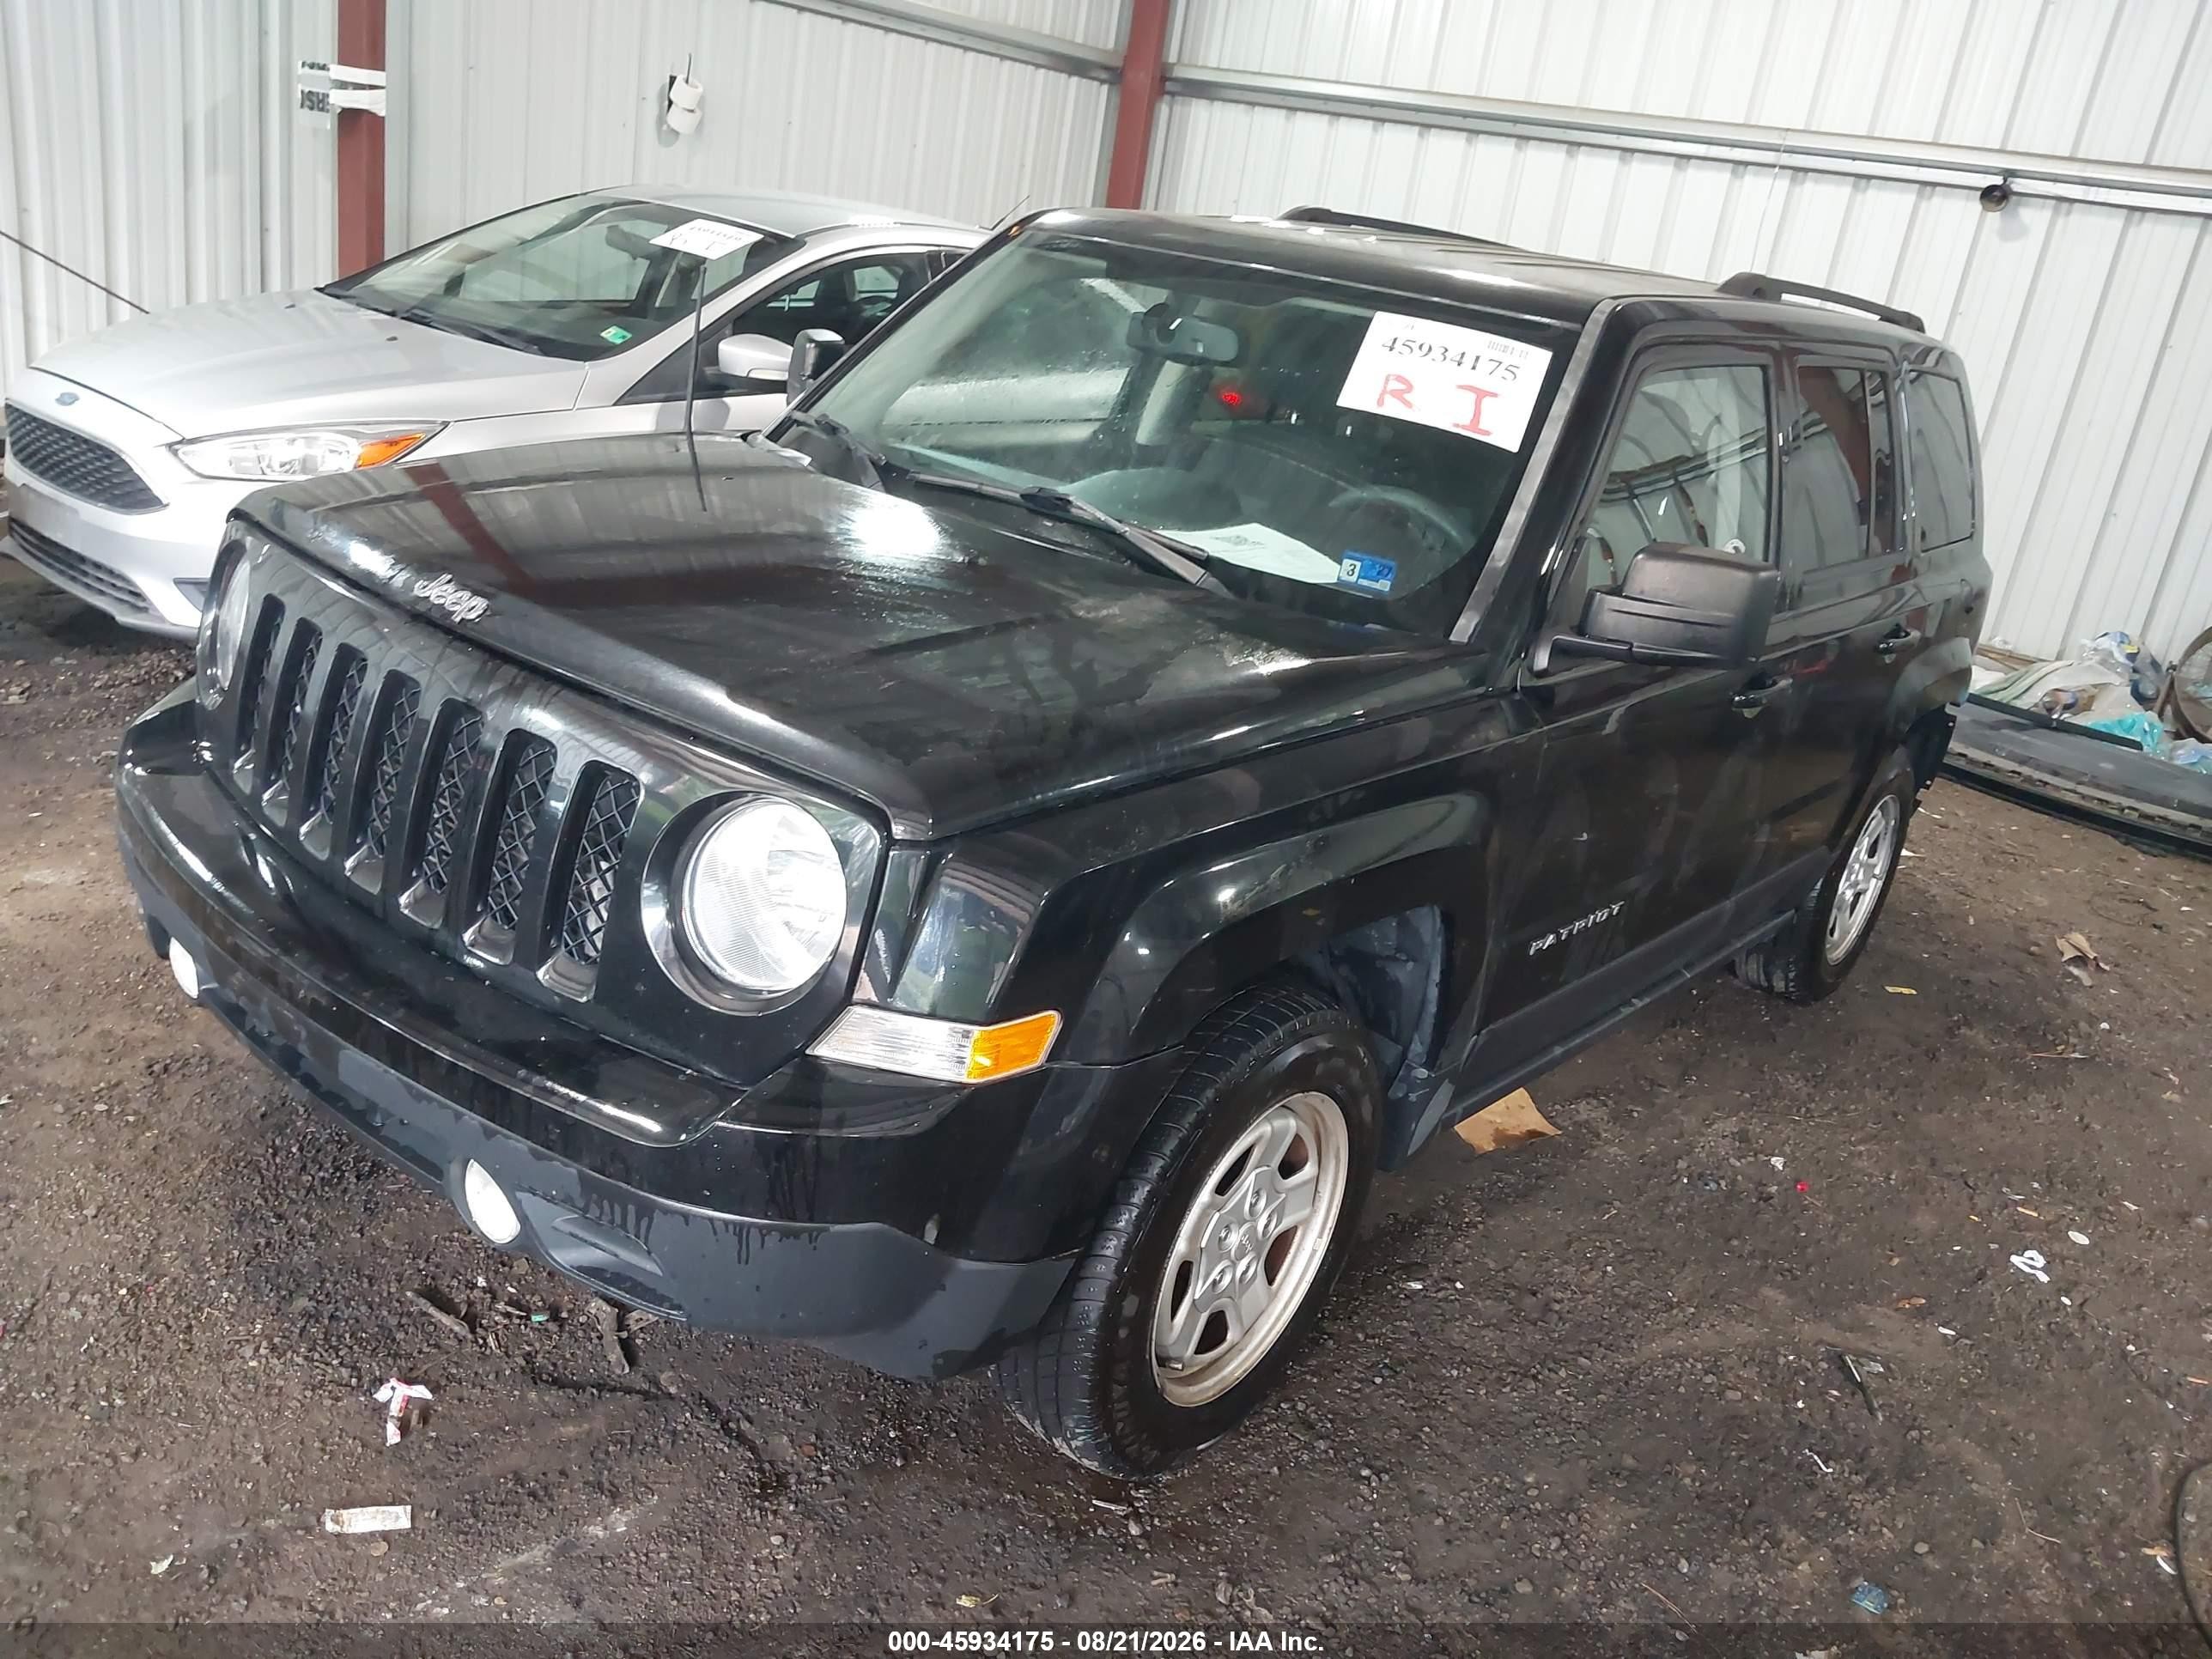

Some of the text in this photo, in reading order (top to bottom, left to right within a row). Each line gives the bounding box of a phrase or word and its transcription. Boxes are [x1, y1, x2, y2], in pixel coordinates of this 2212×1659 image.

[1381, 336, 1522, 383] 45934175
[1376, 374, 1415, 410] R
[1346, 562, 1358, 577] 3
[413, 573, 491, 625] Jeep
[1528, 900, 1626, 956] PATRIOT
